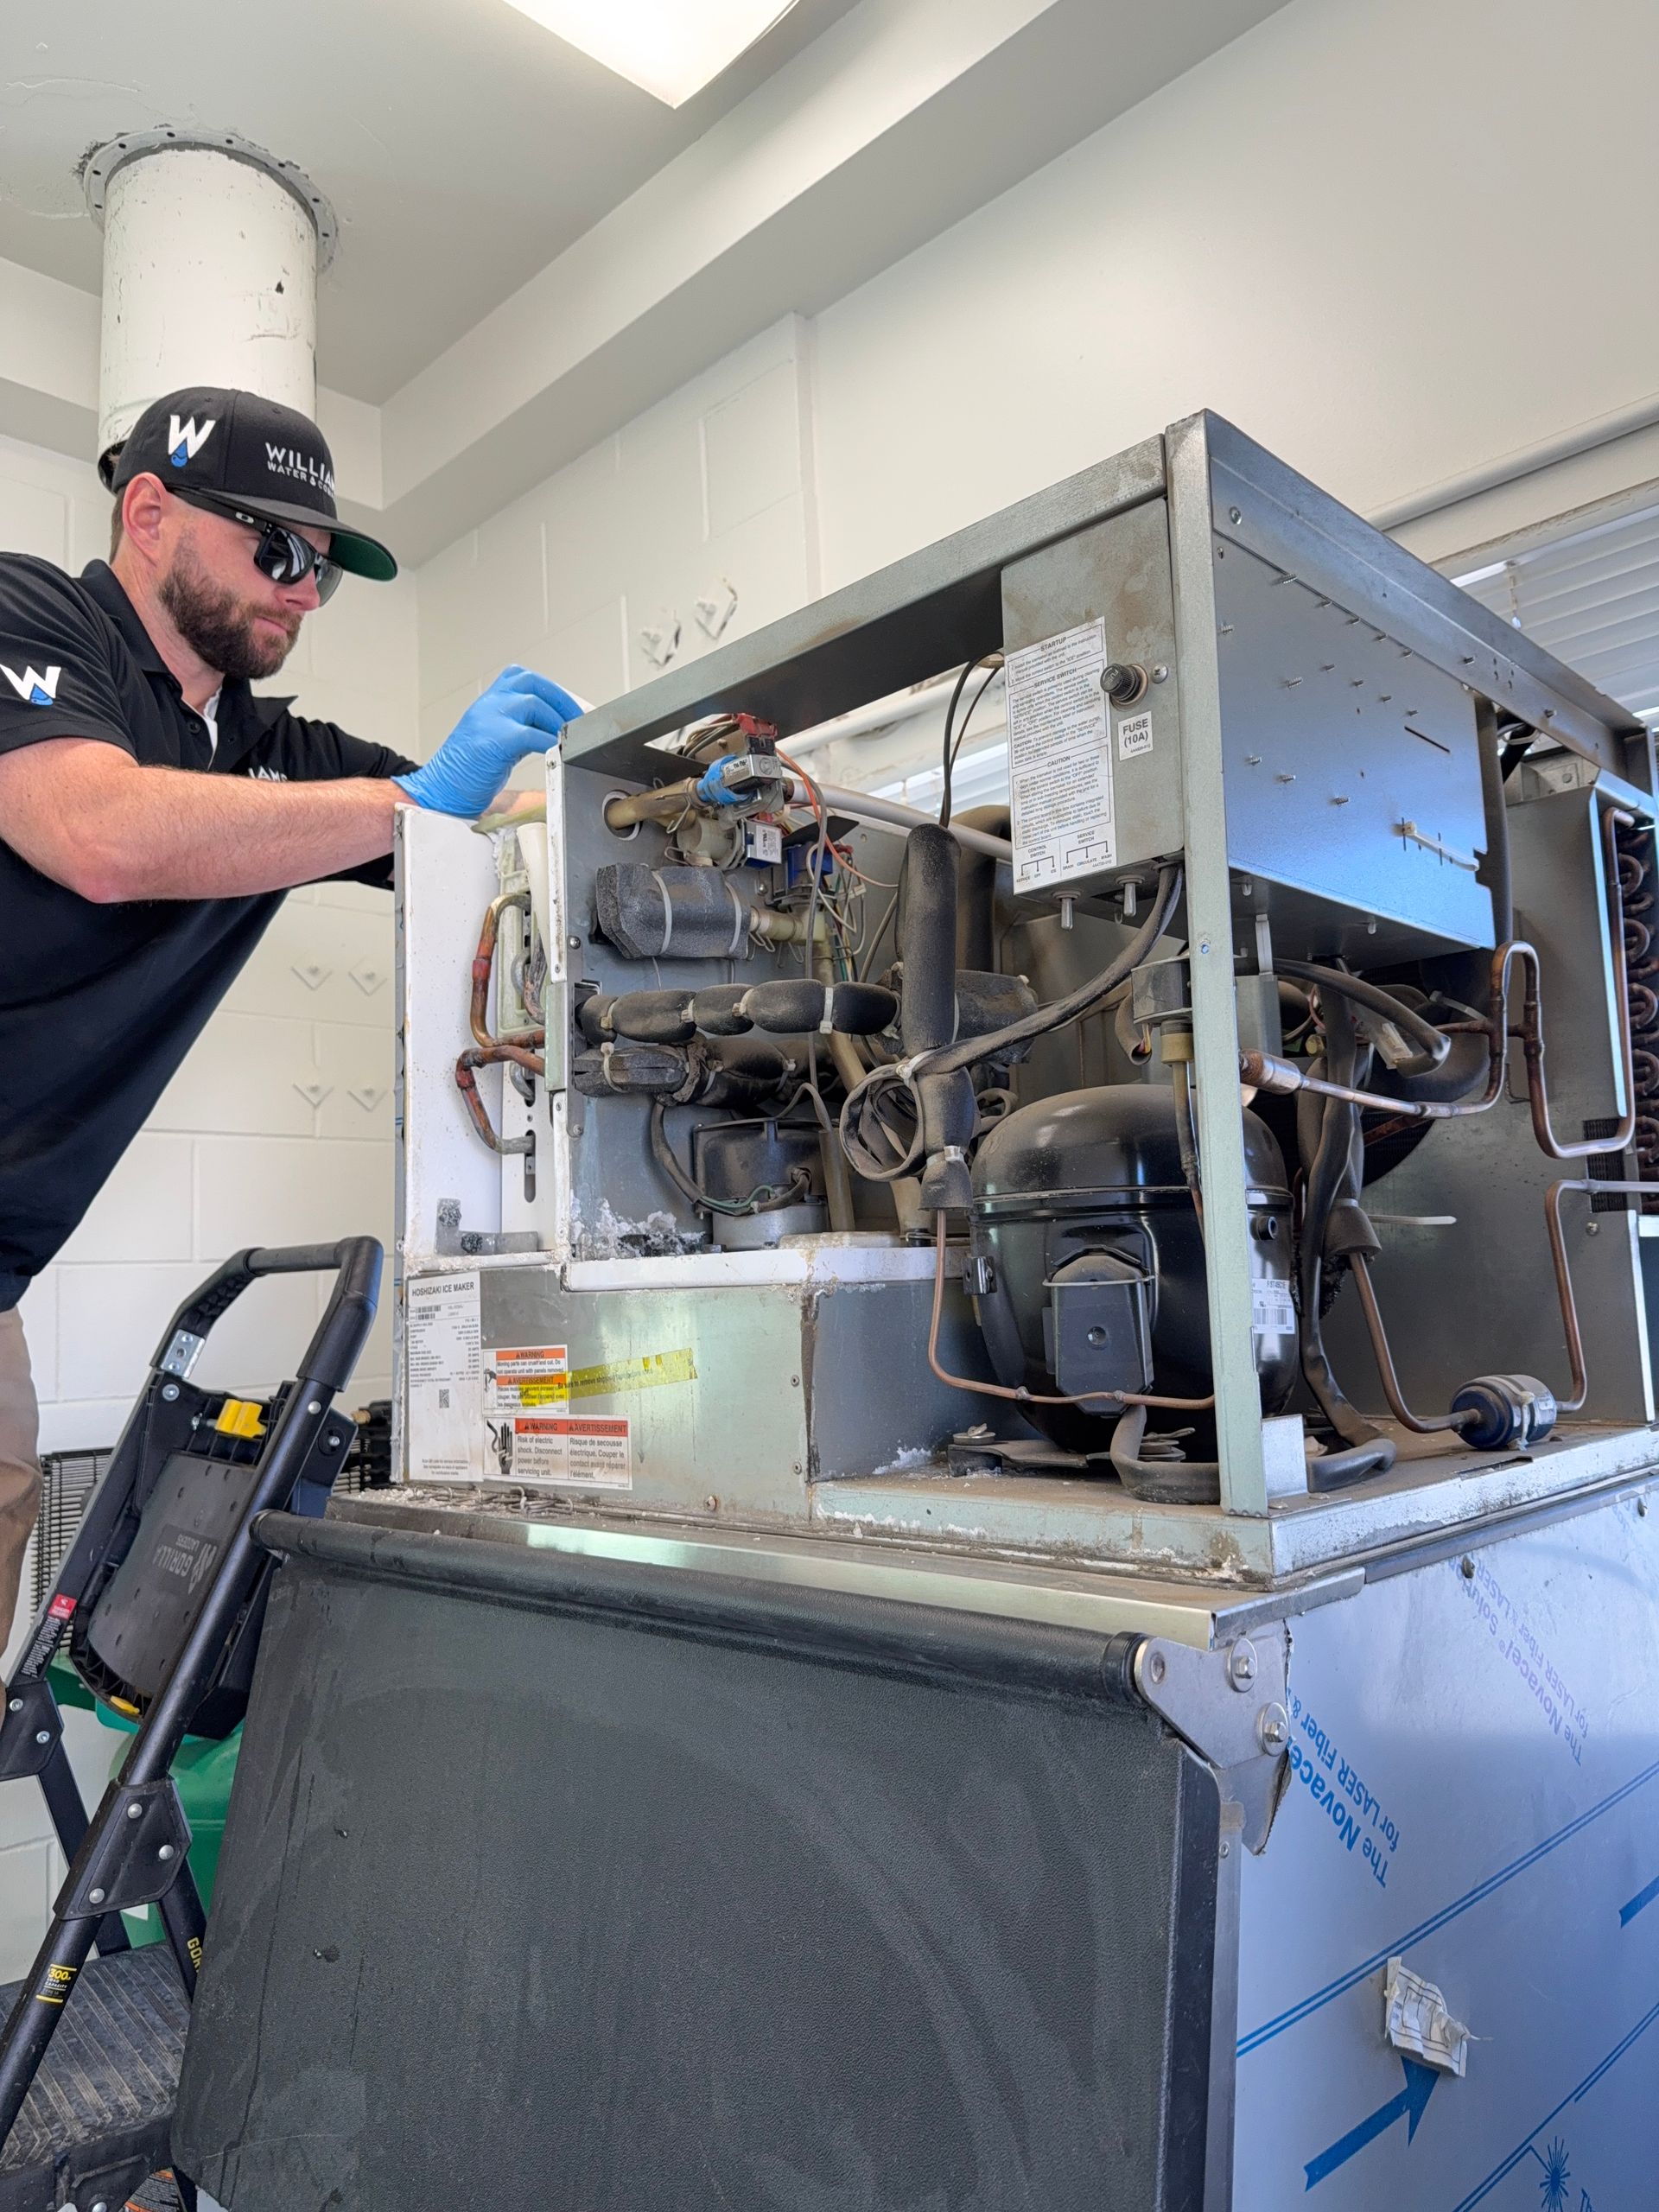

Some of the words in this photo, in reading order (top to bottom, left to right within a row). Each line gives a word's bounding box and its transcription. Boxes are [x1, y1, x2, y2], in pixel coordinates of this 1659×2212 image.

[168, 415, 216, 460] W
[265, 442, 335, 492] WILLIA
[267, 461, 307, 481] WATER
[1040, 637, 1067, 652] STARTUP
[0, 664, 62, 701] W
[1033, 676, 1056, 689] SERVICE
[1057, 668, 1077, 680] SWITCH
[1122, 718, 1149, 735] FUSE
[1124, 731, 1149, 748] (10A)
[1046, 756, 1071, 767] CAUTION
[412, 1286, 442, 1297] HOSHIZAKI
[454, 1281, 474, 1292] MAKER
[521, 1351, 544, 1359] WARNING
[513, 1376, 554, 1384] AVERTISSEMENT
[575, 1423, 627, 1433] AVERTISSEMENT
[570, 1438, 588, 1446] Risque
[598, 1450, 619, 1459] Couper
[518, 1468, 540, 1477] servicing
[153, 1544, 194, 1578] GORILLA
[1519, 1624, 1545, 1669] Fiber
[1546, 1659, 1575, 1716] LASER
[1293, 1696, 1302, 1719] &
[1575, 1708, 1589, 1738] for
[1300, 1713, 1338, 1770] Fiber
[1564, 1725, 1582, 1767] The
[1287, 1736, 1362, 1852] Novace
[1338, 1757, 1381, 1827] LASER
[1380, 1816, 1400, 1853] for
[1362, 1837, 1389, 1889] The
[187, 1936, 203, 1974] GOR
[48, 1967, 69, 1980] 300
